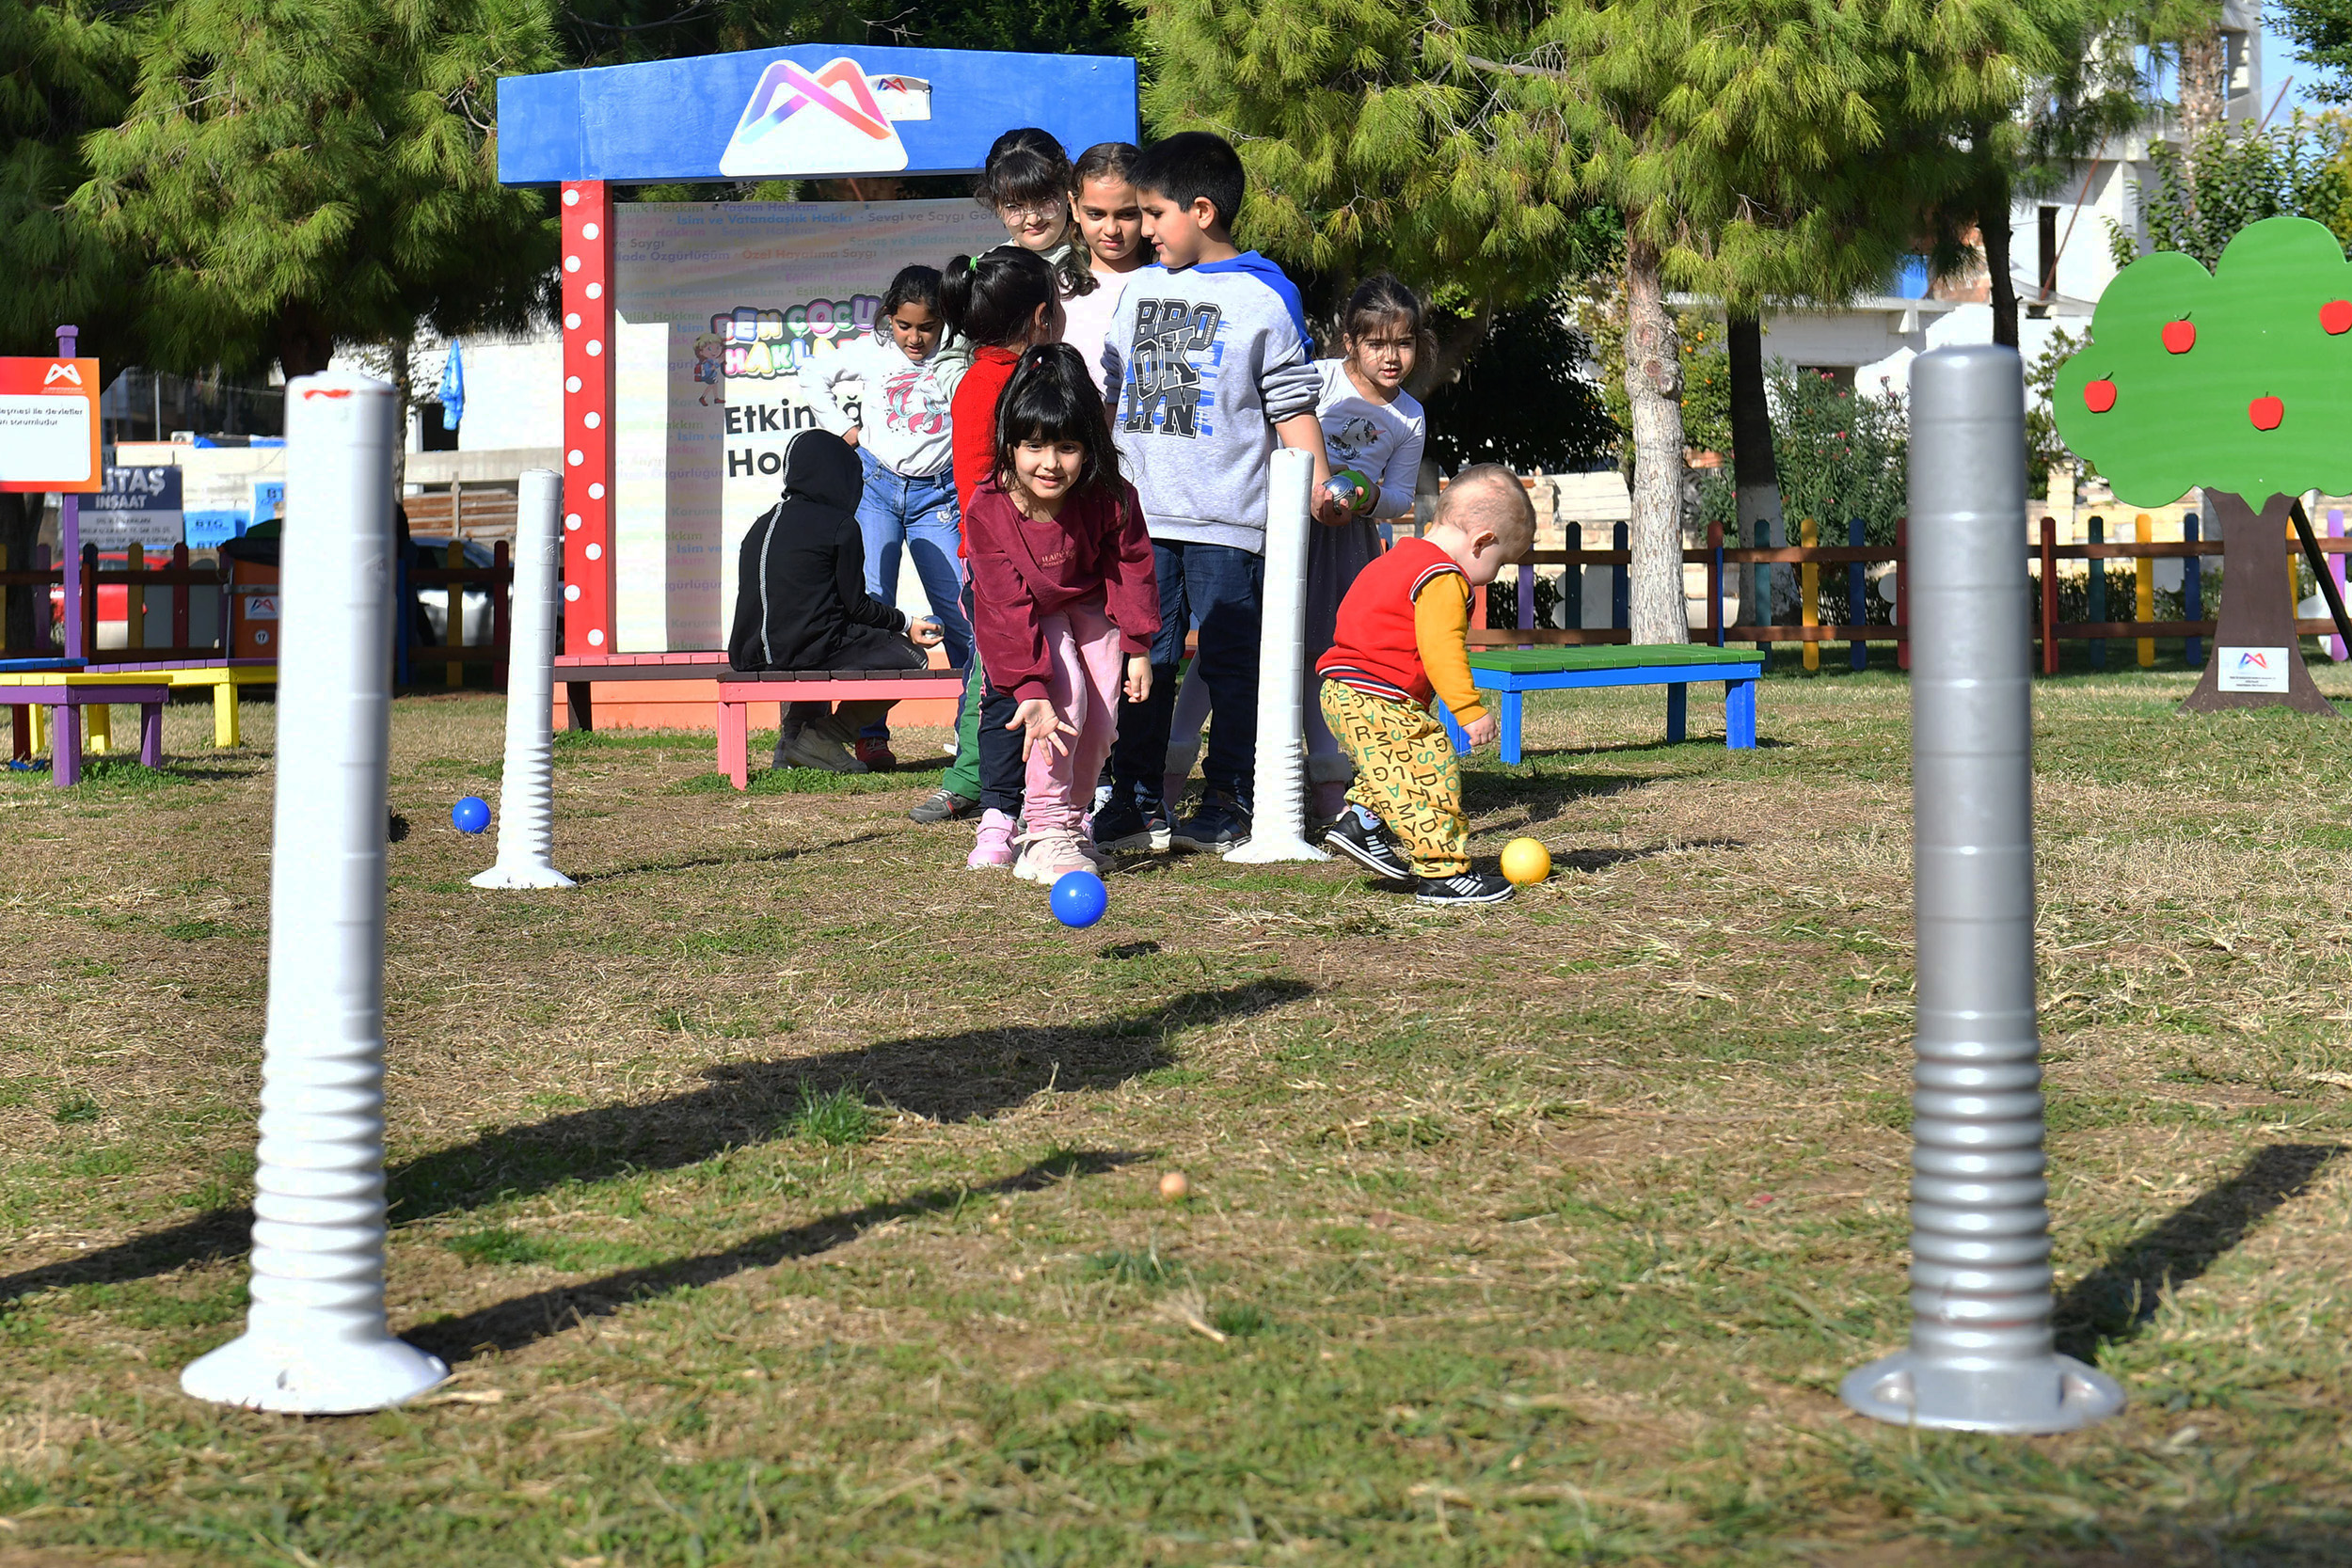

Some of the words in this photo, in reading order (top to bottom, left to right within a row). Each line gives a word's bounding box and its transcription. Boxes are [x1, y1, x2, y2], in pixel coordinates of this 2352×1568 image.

[677, 214, 705, 225] İsim
[708, 216, 723, 225] ve
[728, 214, 807, 226] Vatandaşlık
[812, 212, 851, 223] Hakkı
[868, 211, 903, 224] Sevgi
[908, 213, 924, 221] ve
[928, 211, 964, 224] Saygı
[629, 238, 664, 250] Saygı
[742, 248, 771, 260] Özel
[842, 248, 877, 260] Saygı
[713, 307, 783, 342] BEN
